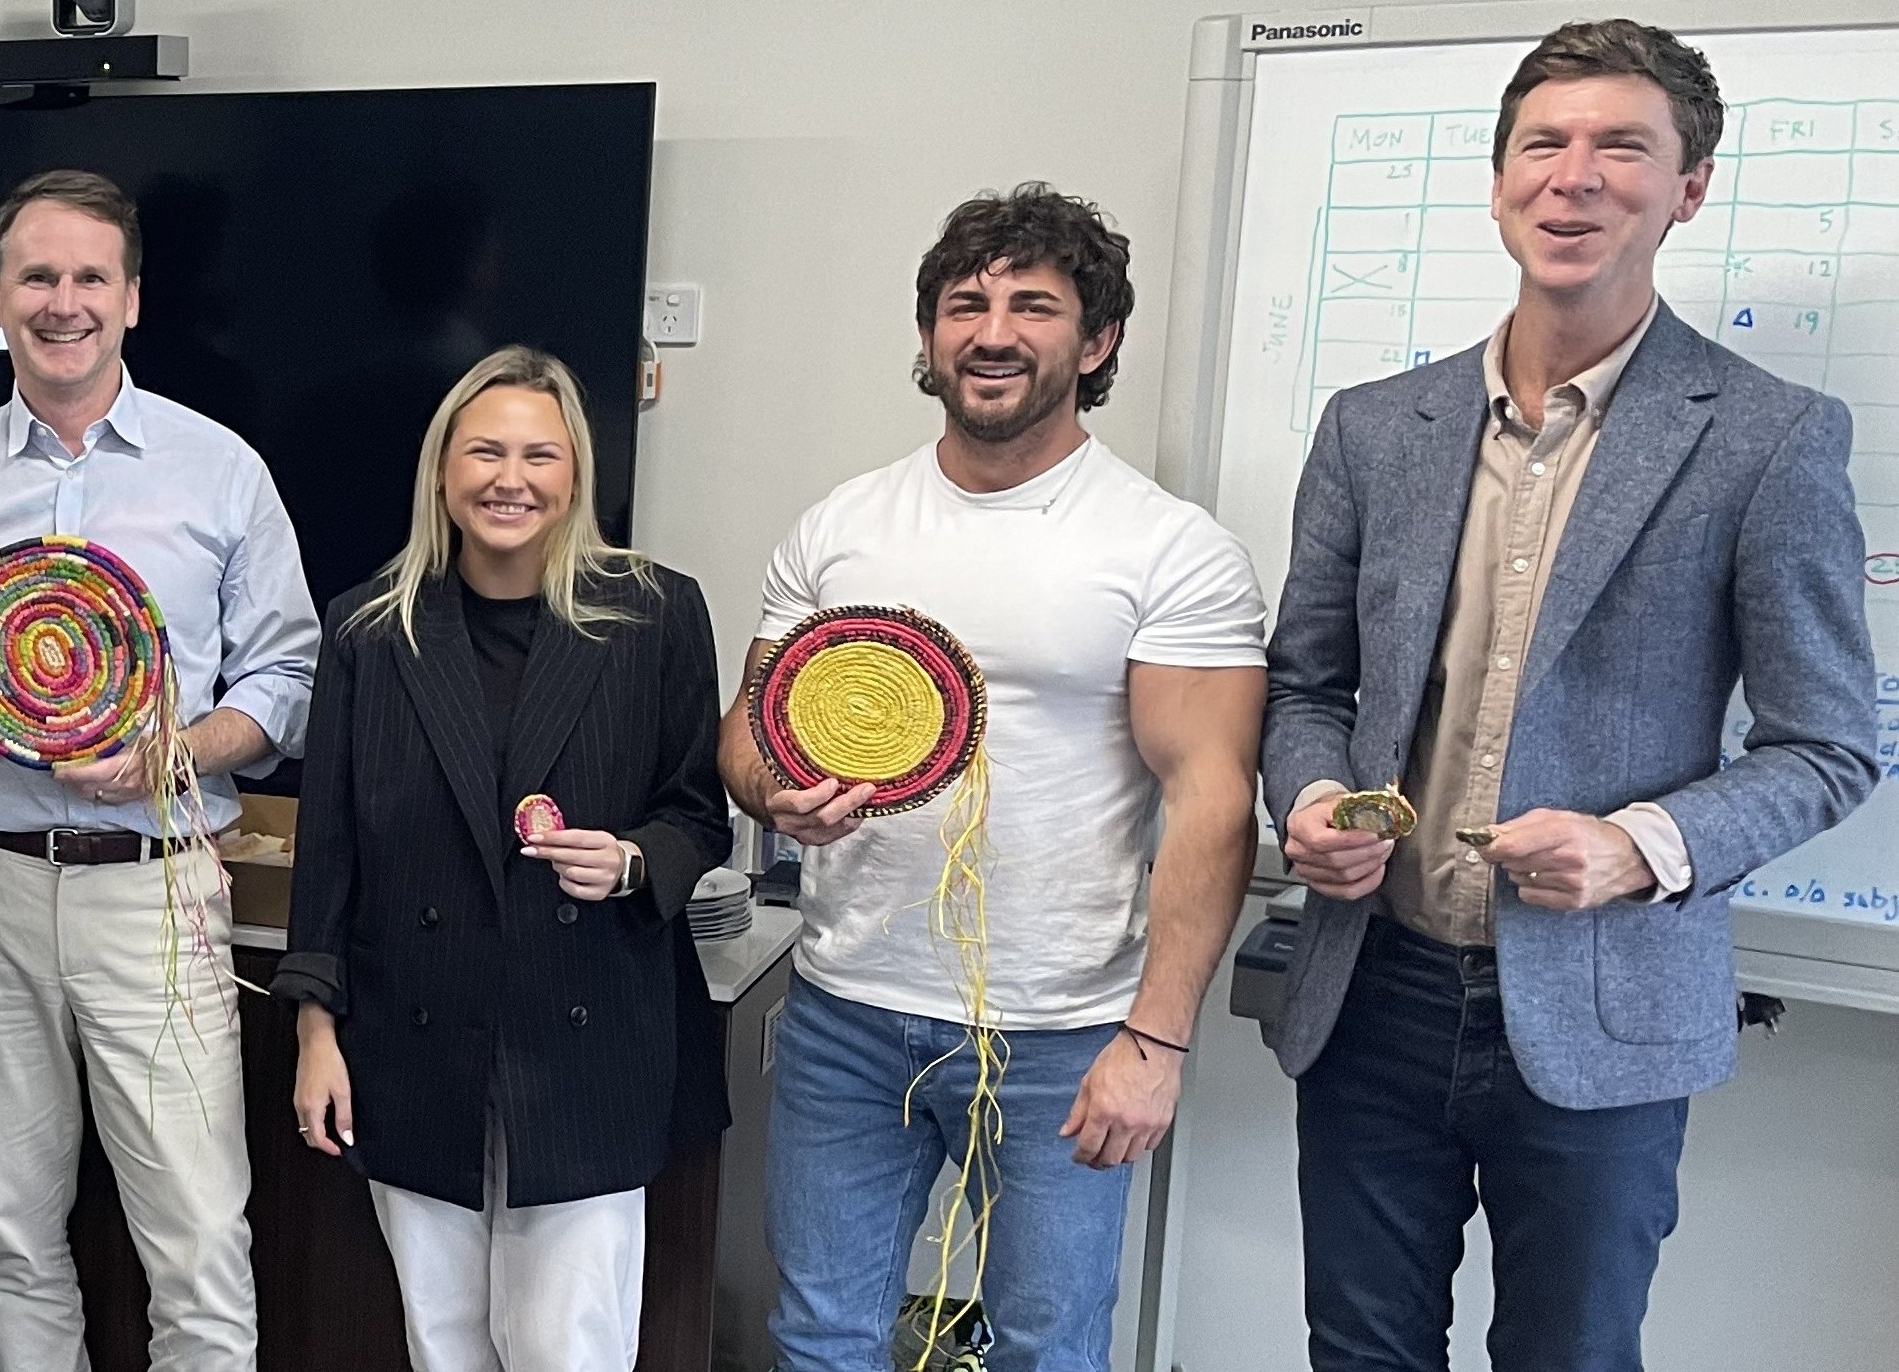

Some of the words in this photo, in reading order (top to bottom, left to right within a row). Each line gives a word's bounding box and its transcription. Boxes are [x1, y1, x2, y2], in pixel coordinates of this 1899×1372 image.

[1251, 19, 1363, 41] Panasonic
[1349, 128, 1404, 152] MON
[1446, 123, 1492, 146] TUE
[1769, 119, 1815, 142] FRI
[1818, 208, 1835, 234] 5
[1807, 259, 1832, 278] 12
[1794, 310, 1820, 336] 19
